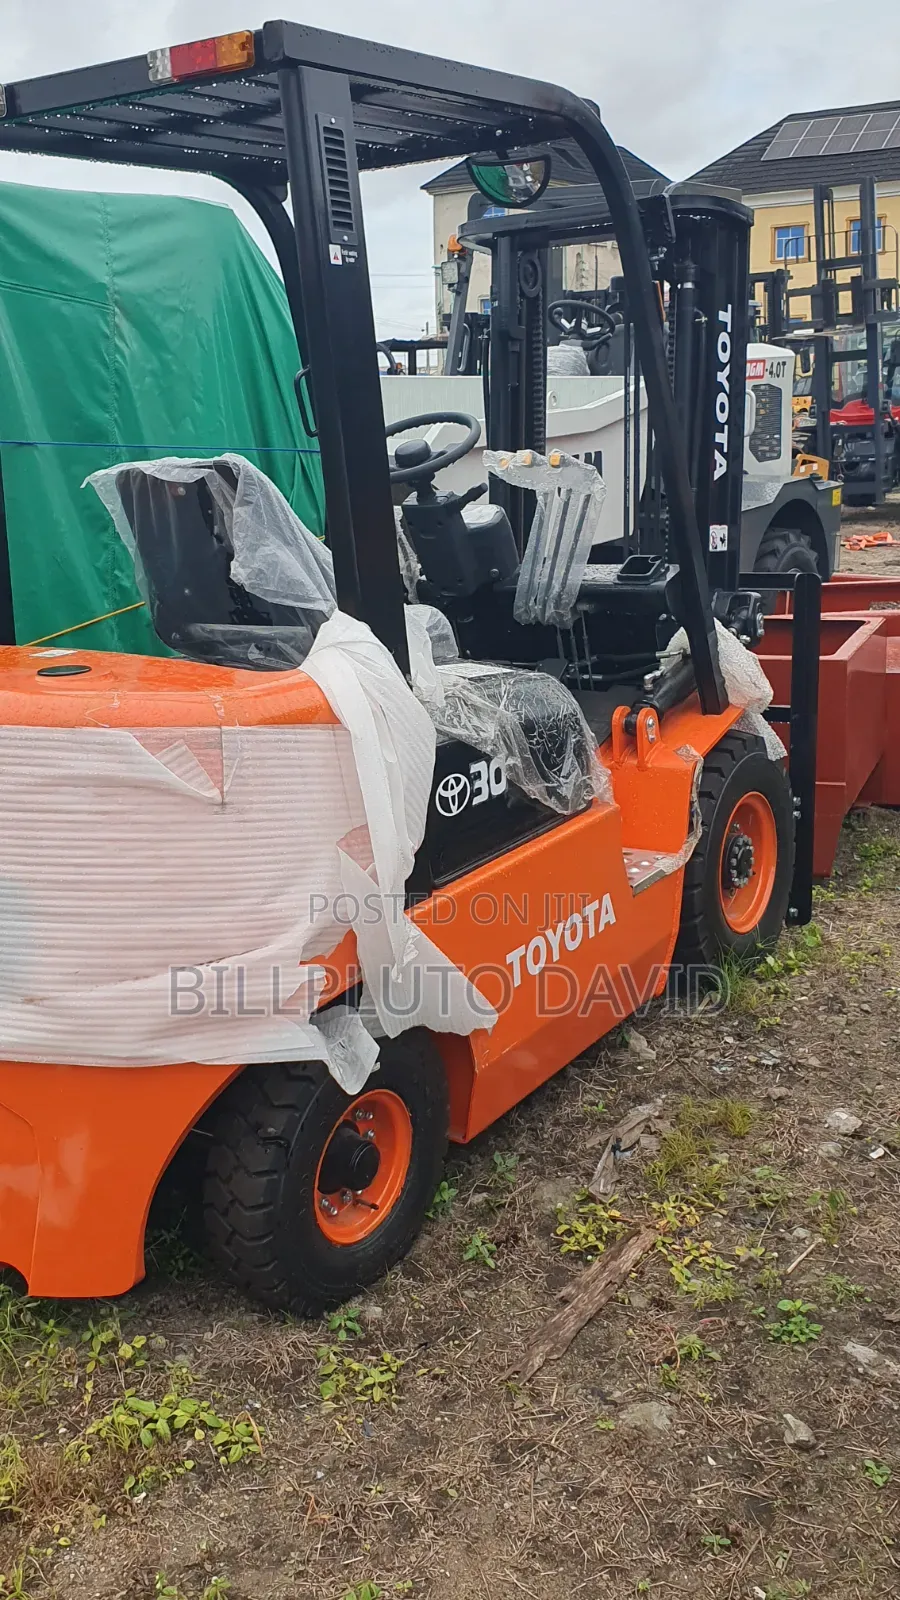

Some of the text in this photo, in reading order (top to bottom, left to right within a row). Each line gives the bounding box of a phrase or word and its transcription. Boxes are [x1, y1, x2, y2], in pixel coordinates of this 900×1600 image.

[713, 303, 732, 482] TOYOTA
[469, 755, 507, 806] 30
[505, 892, 617, 988] TOYOTA
